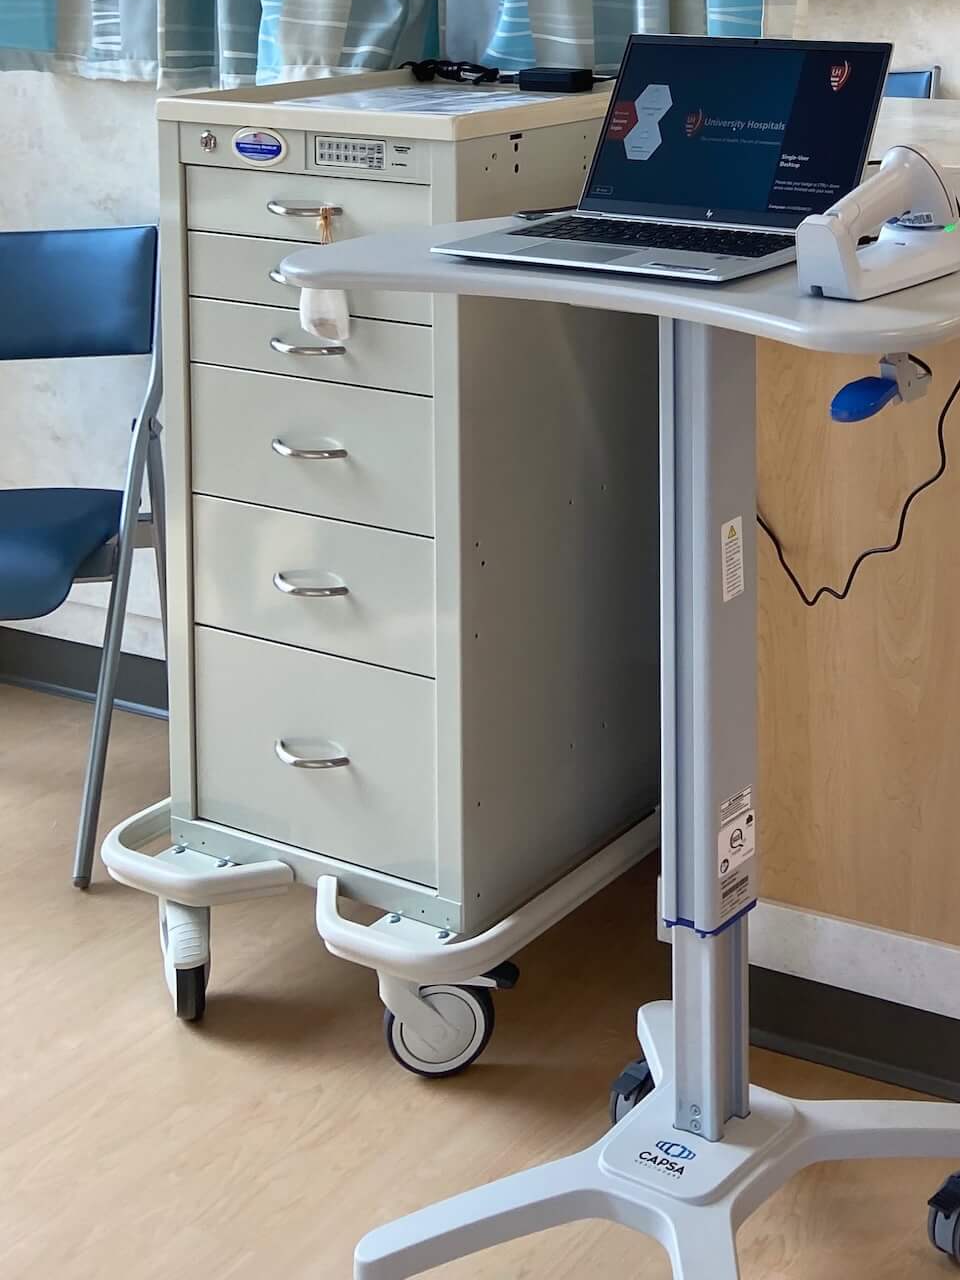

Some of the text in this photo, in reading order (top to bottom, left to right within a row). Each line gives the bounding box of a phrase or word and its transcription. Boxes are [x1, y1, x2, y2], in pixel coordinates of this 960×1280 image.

[704, 118, 785, 131] University Hospitals
[639, 1151, 685, 1175] CAPSA
